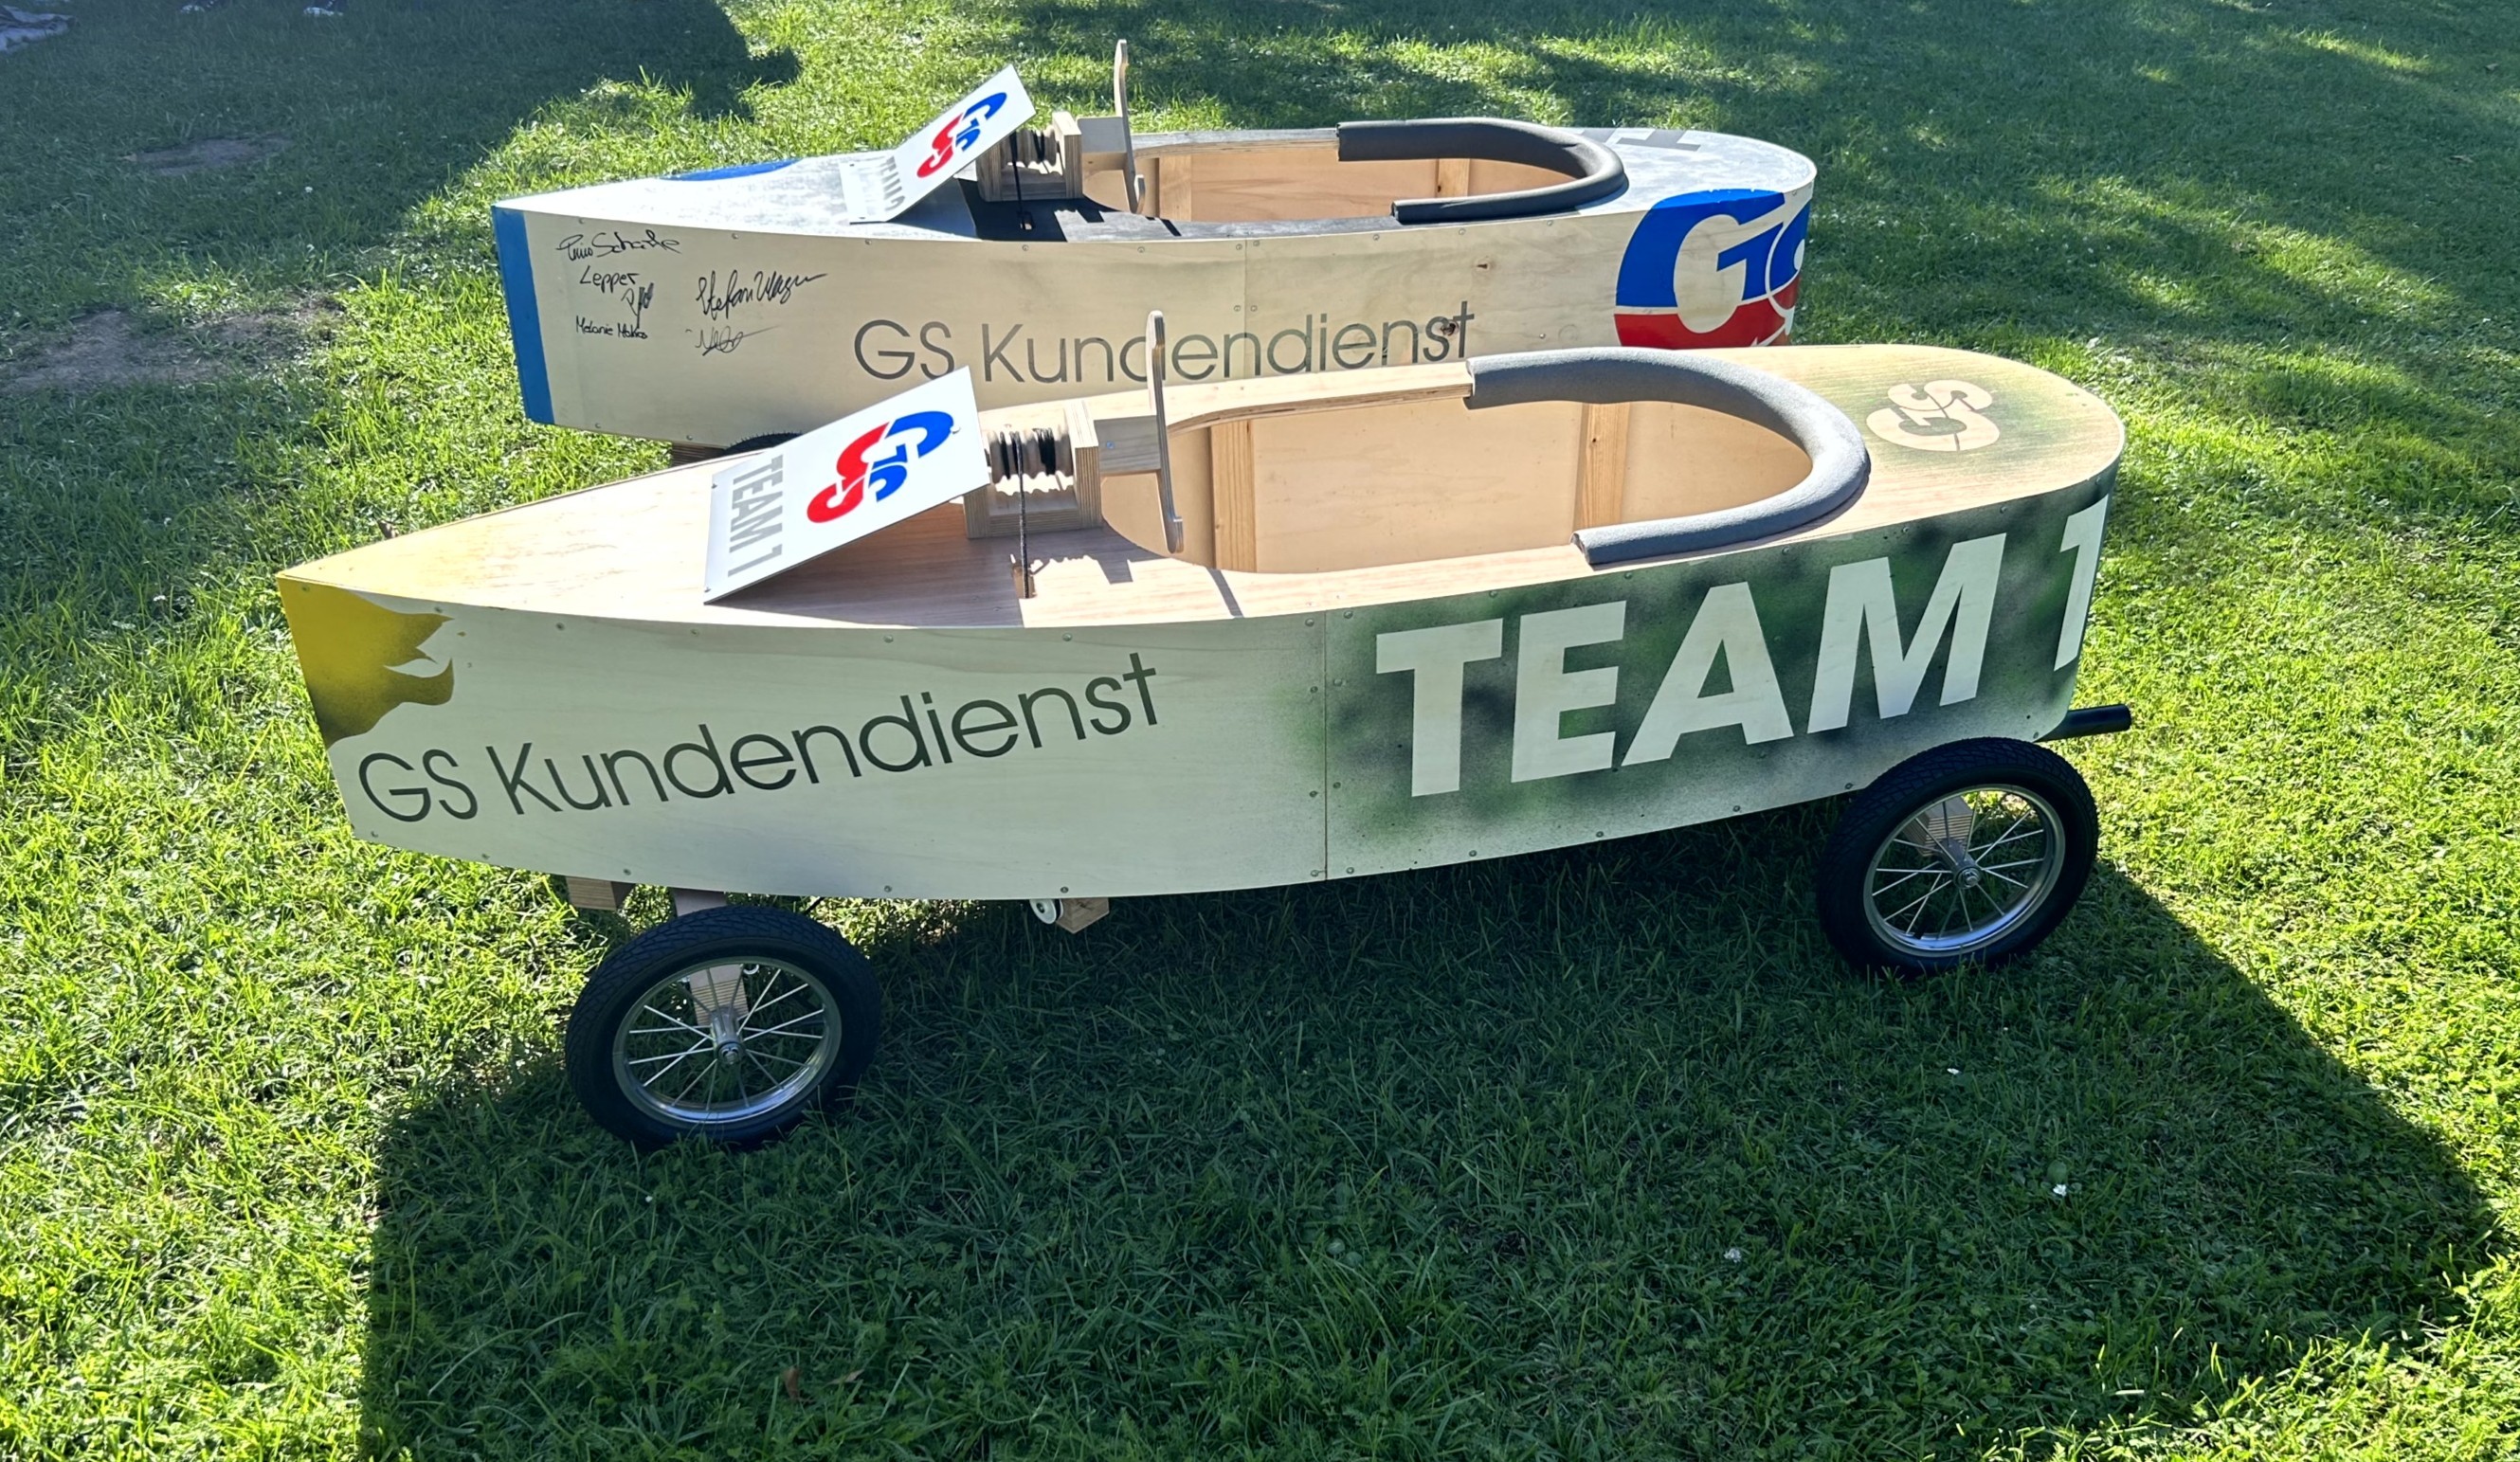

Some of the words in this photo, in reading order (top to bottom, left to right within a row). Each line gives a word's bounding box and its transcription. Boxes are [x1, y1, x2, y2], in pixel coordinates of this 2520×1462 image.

[579, 265, 640, 293] Lepper
[854, 319, 954, 379] GS
[982, 300, 1475, 383] Kundendienst
[729, 454, 784, 553] TEAM
[1376, 532, 2006, 798] TEAM
[2053, 494, 2110, 672] 1
[357, 749, 478, 822] GS
[485, 651, 1159, 816] Kundendienst
